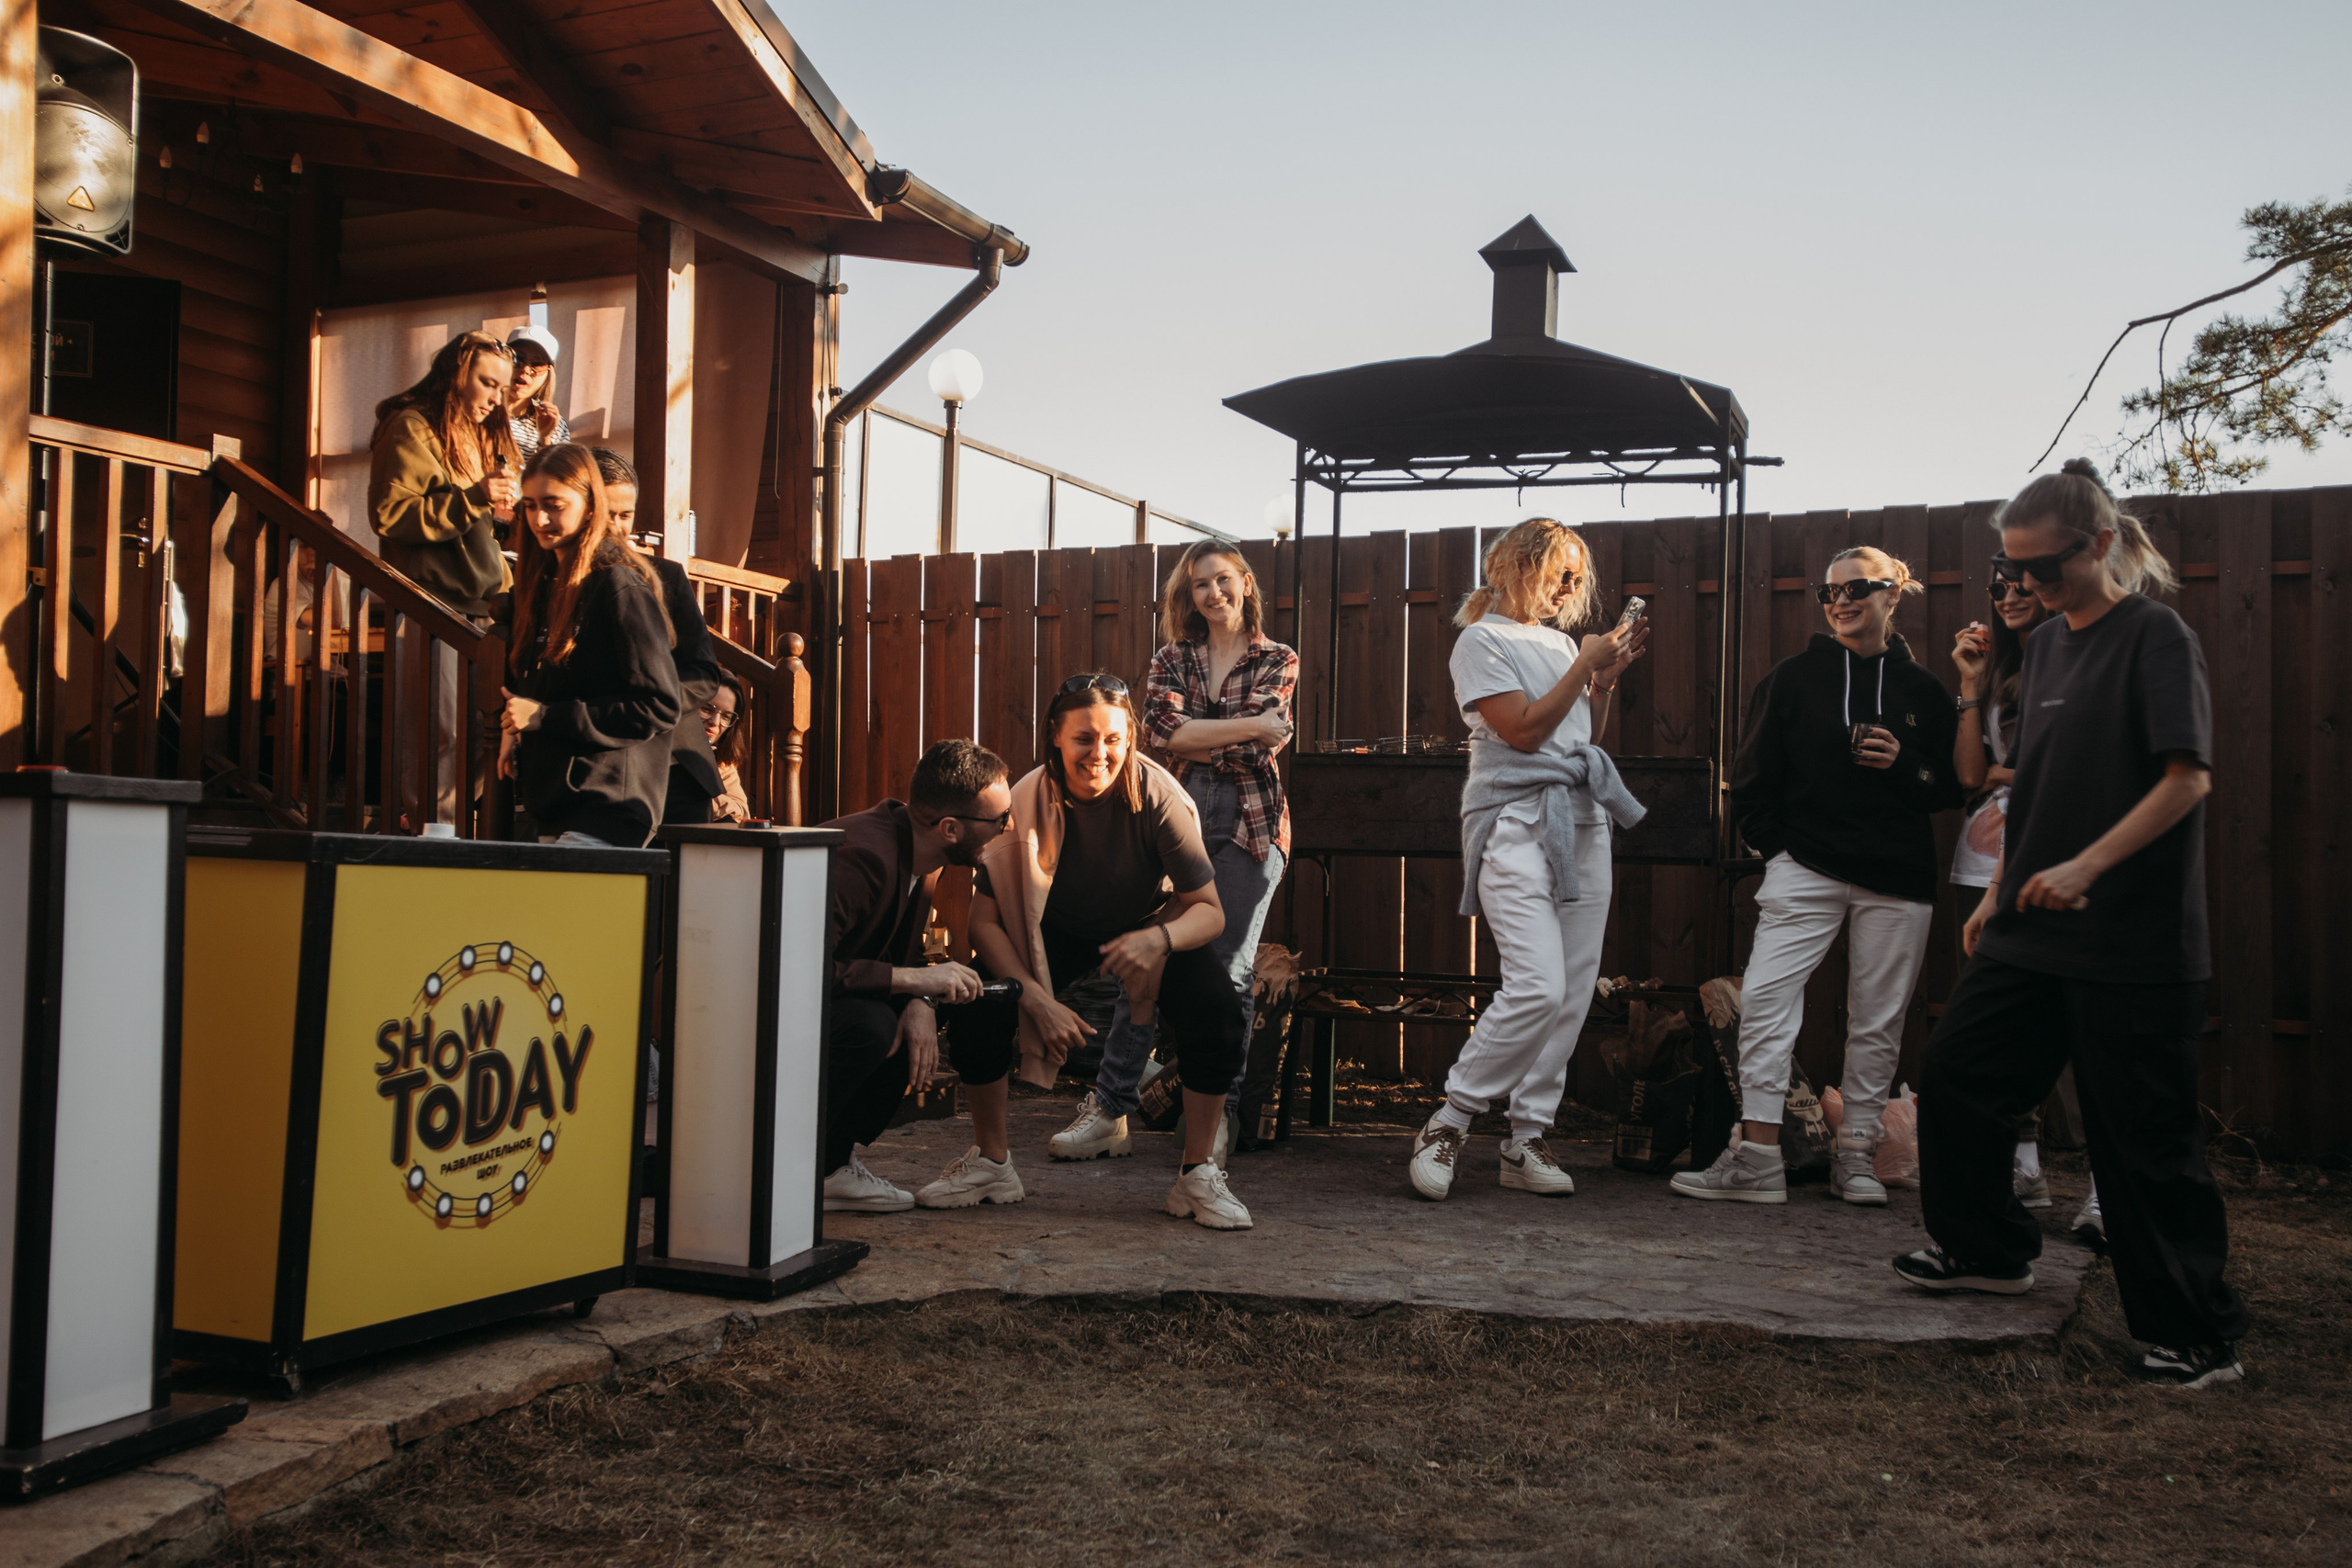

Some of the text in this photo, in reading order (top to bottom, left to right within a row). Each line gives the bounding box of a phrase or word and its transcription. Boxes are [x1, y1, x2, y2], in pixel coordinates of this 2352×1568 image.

[374, 996, 502, 1079] SHOW
[377, 1024, 593, 1168] TODAY
[440, 1136, 533, 1175] РАЗВЛЕКАТЕЛЬНОЕ
[477, 1163, 500, 1180] ШОУ
